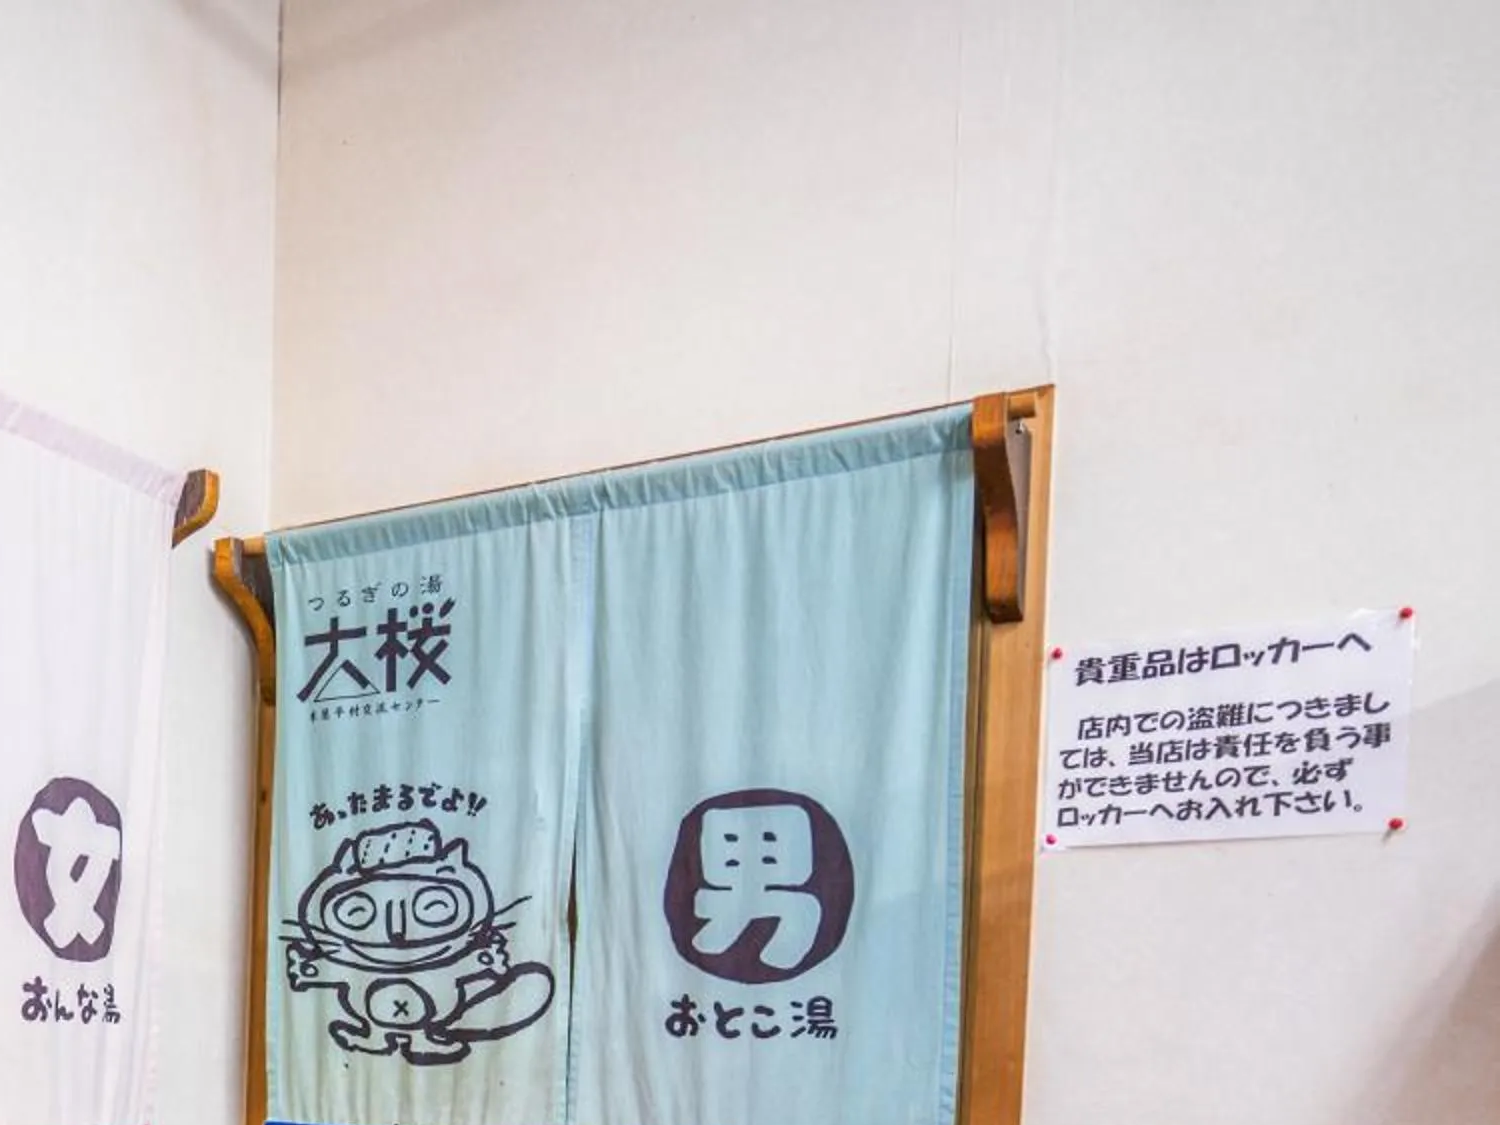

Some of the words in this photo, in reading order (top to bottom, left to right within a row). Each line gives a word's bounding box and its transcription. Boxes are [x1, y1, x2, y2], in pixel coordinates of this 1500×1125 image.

[308, 573, 443, 612] つるぎの湯
[297, 597, 456, 702] 大桜
[1074, 632, 1372, 687] 貴重品はロッカーへ
[1076, 692, 1391, 741] 店内での盗難につきまし
[1059, 722, 1392, 770] ては、当店は責任を負う事
[1057, 757, 1355, 801] ができませんので、必ず
[1056, 789, 1364, 828] ロッカーへお入れ下さい。
[31, 796, 121, 949] 女
[691, 804, 822, 970] 男
[665, 993, 839, 1040] おとこ湯
